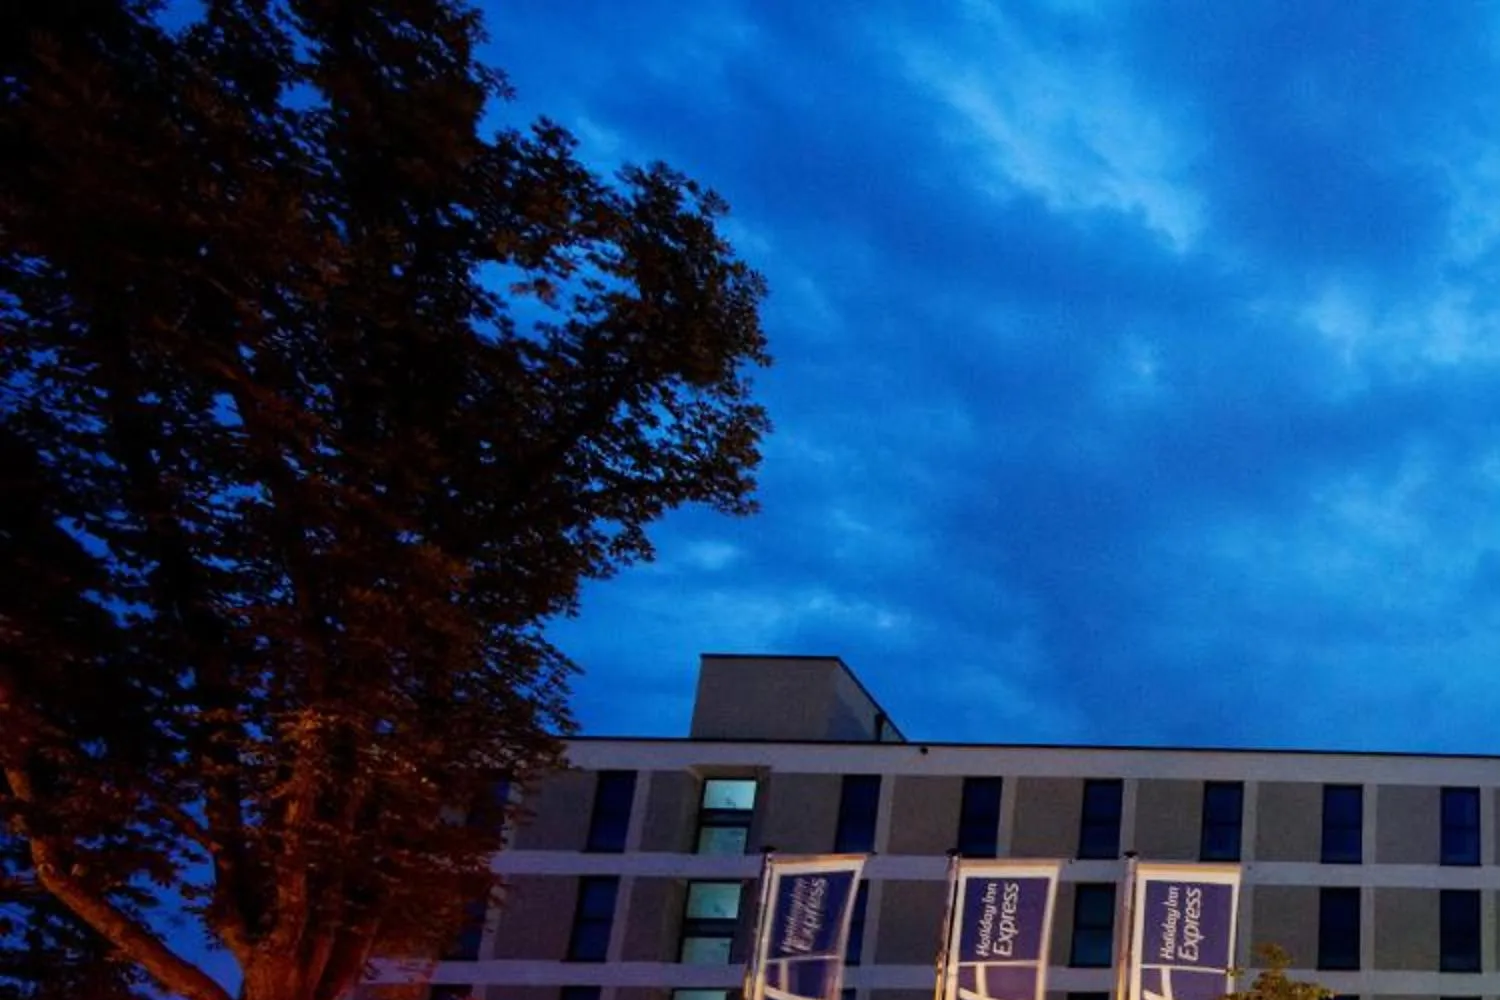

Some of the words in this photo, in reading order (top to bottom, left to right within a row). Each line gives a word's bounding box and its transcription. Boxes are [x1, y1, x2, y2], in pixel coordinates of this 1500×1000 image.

[790, 878, 827, 952] Express
[981, 883, 998, 904] Inn
[993, 882, 1019, 957] Express
[1161, 886, 1180, 907] Inn
[976, 904, 998, 956] Holiday
[1160, 907, 1181, 959] Holiday
[1178, 887, 1206, 961] Express
